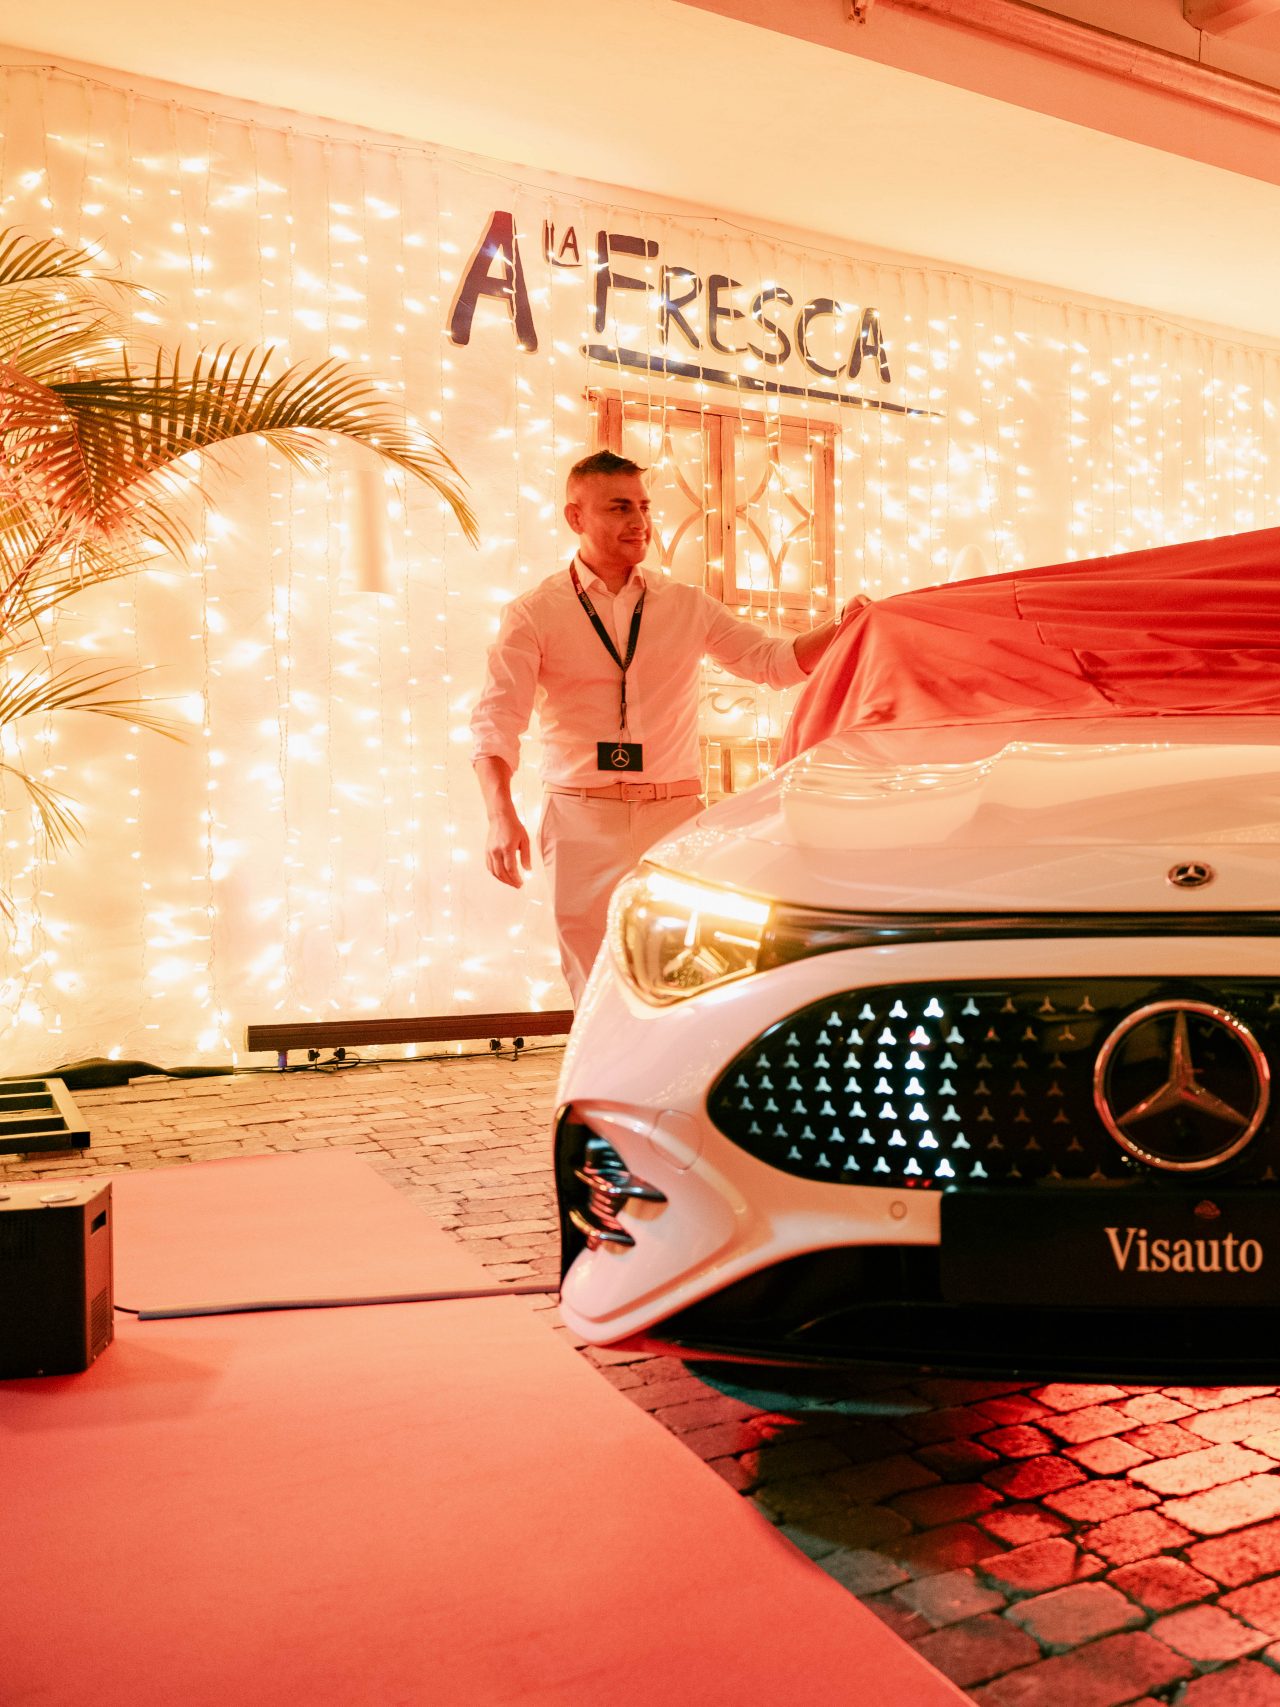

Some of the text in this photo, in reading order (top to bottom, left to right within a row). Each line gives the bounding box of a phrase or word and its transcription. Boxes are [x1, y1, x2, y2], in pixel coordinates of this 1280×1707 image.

[449, 210, 892, 384] A LA FRESCA
[1104, 1227, 1264, 1273] Visauto
